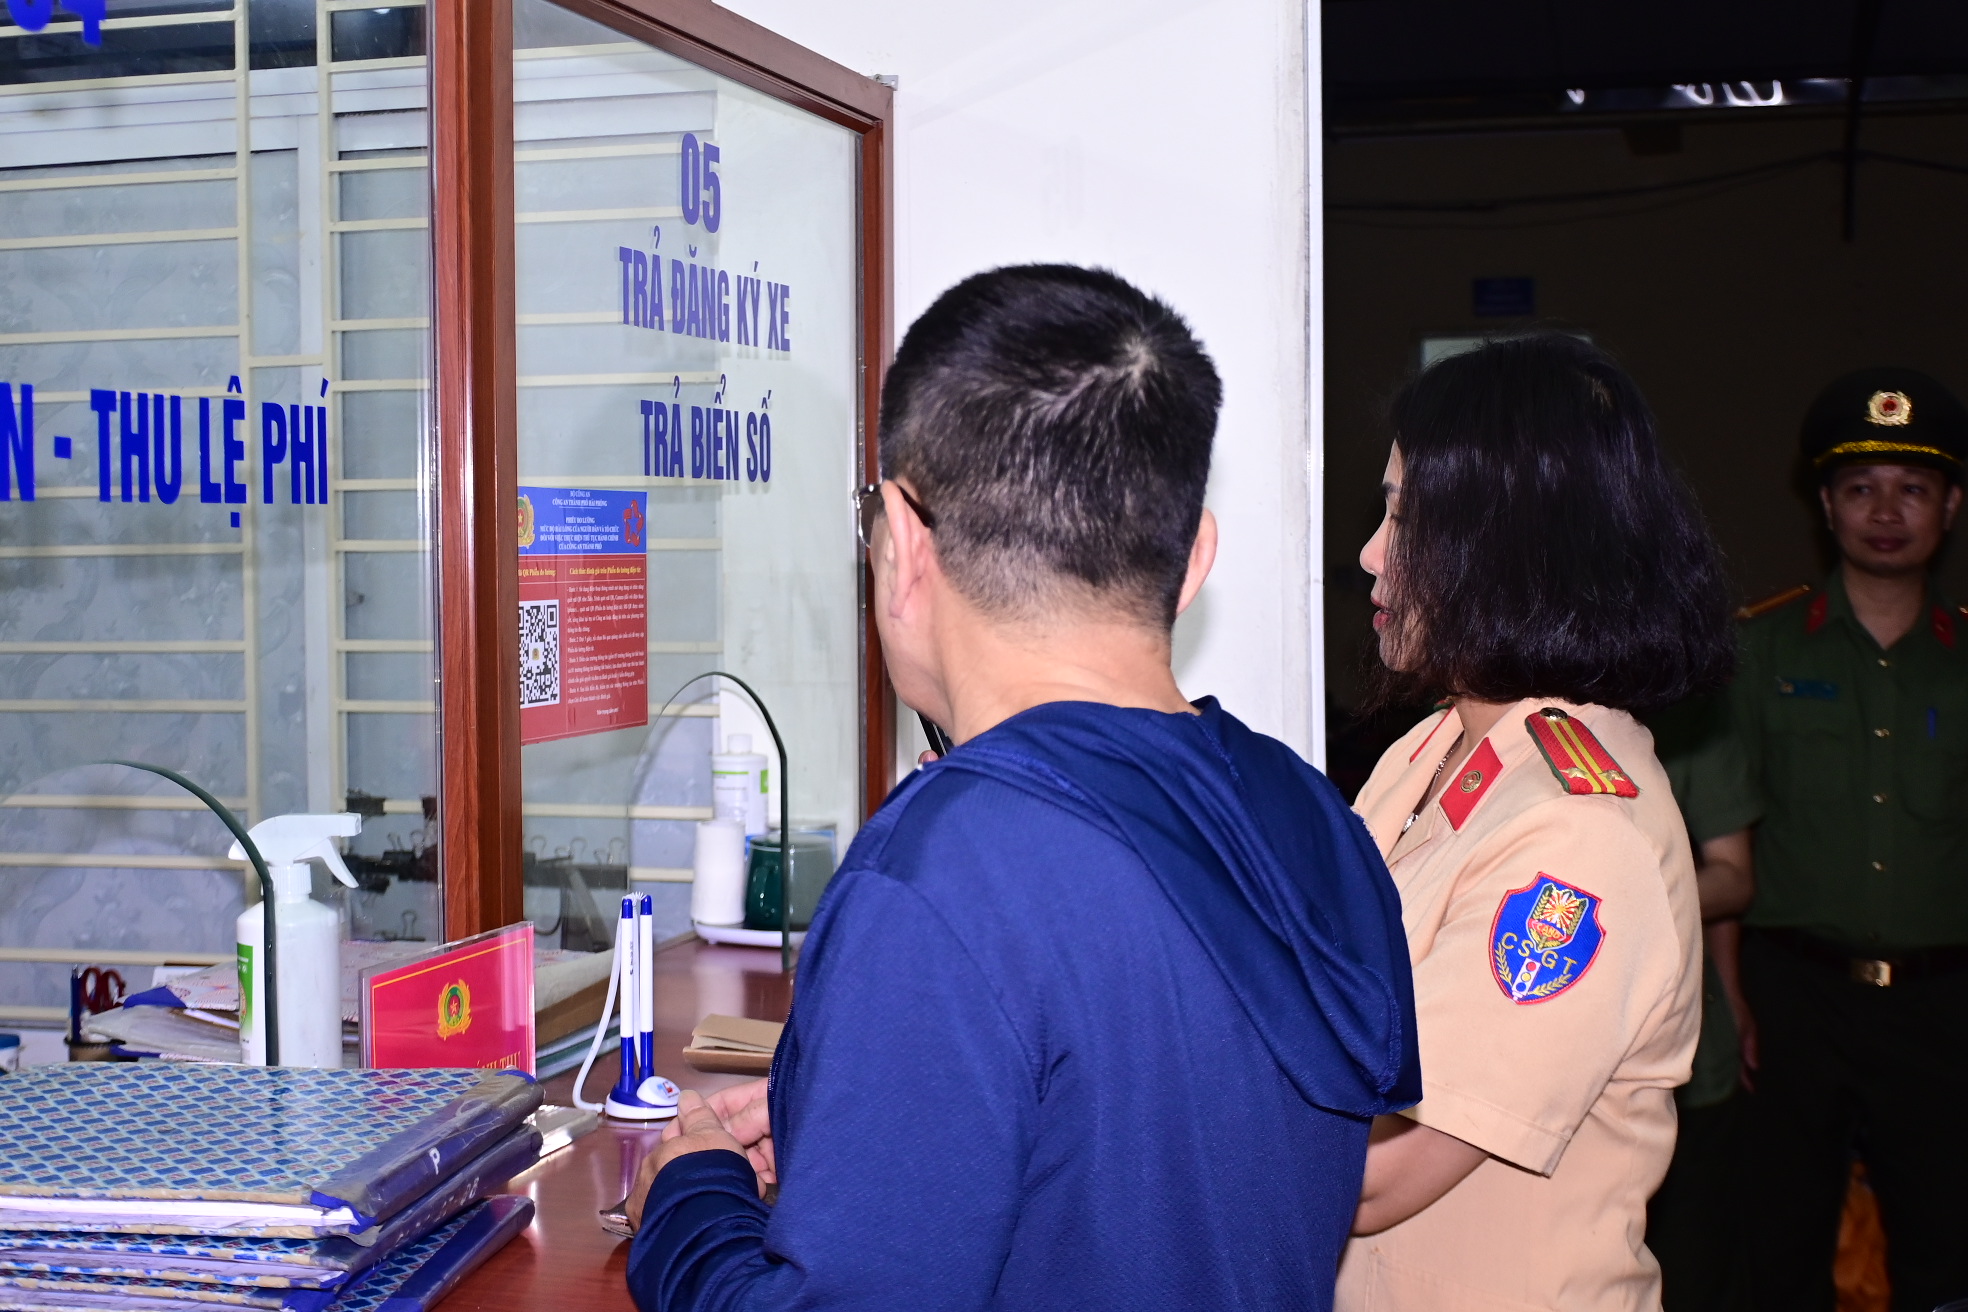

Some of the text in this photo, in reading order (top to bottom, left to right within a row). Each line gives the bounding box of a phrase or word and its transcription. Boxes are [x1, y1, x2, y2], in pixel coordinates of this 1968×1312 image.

[680, 132, 721, 234] 05
[619, 225, 791, 352] TRẢ ĐĂNG KÝ XE
[90, 388, 184, 505] THU
[199, 375, 247, 529] LỆ
[262, 378, 329, 505] PHÍ
[640, 373, 772, 483] TRẢ BIỂN SỐ
[1501, 932, 1578, 974] CSGT
